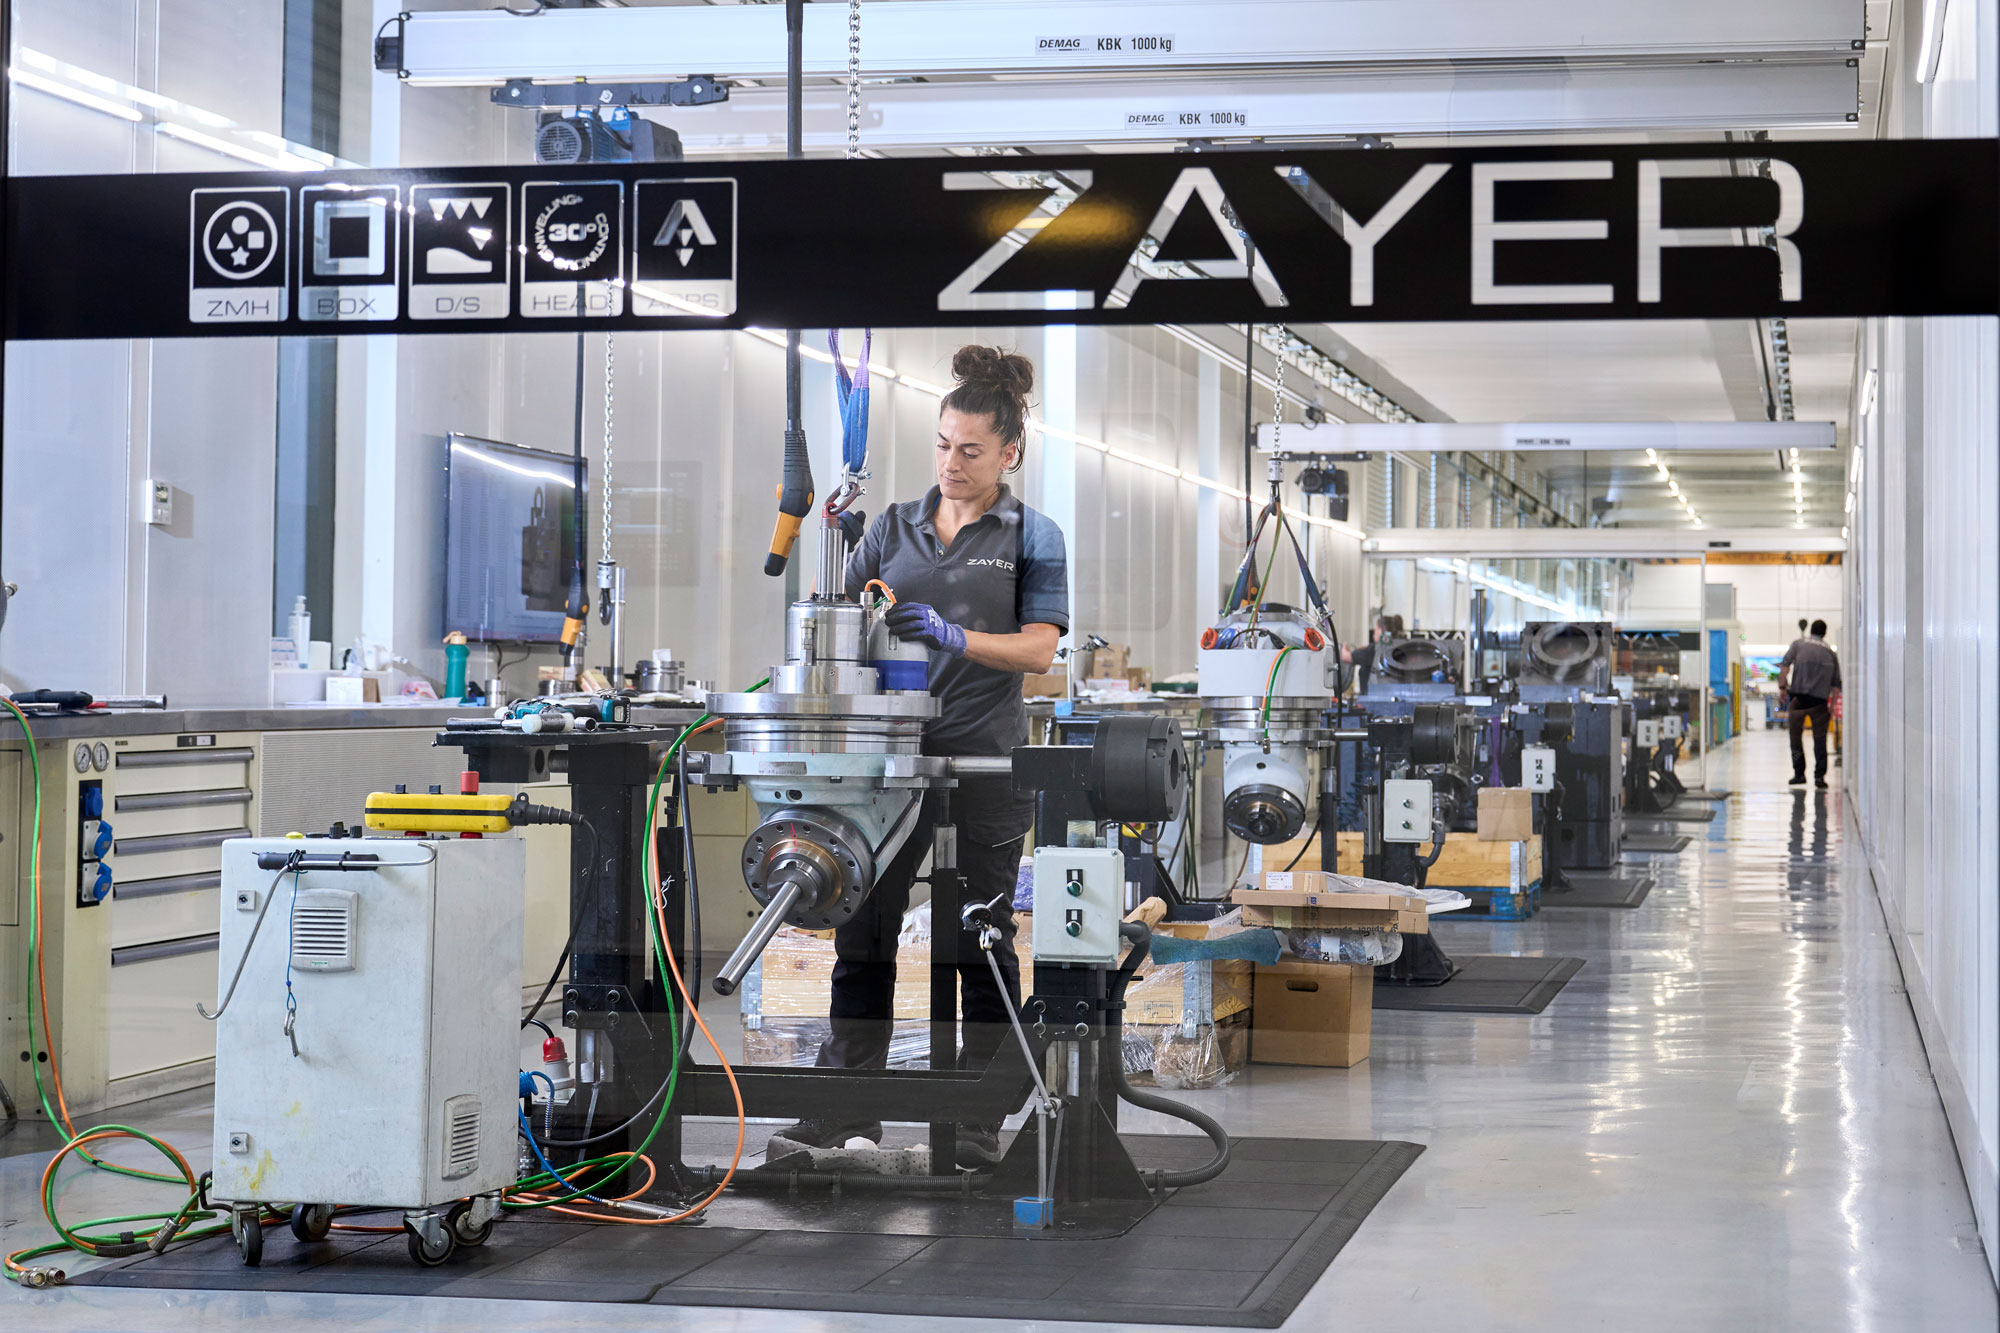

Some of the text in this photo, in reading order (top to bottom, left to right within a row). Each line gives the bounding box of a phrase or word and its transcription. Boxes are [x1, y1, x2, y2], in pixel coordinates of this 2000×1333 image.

[1039, 37, 1172, 52] DEMAG KBK 1000 kg
[1128, 112, 1246, 126] DEMAG KBK 1000 kg
[937, 158, 1804, 311] ZAYER
[207, 300, 270, 317] ZMH
[317, 298, 377, 315] BOX
[435, 296, 481, 314] D/S
[966, 558, 1015, 571] ZAYER
